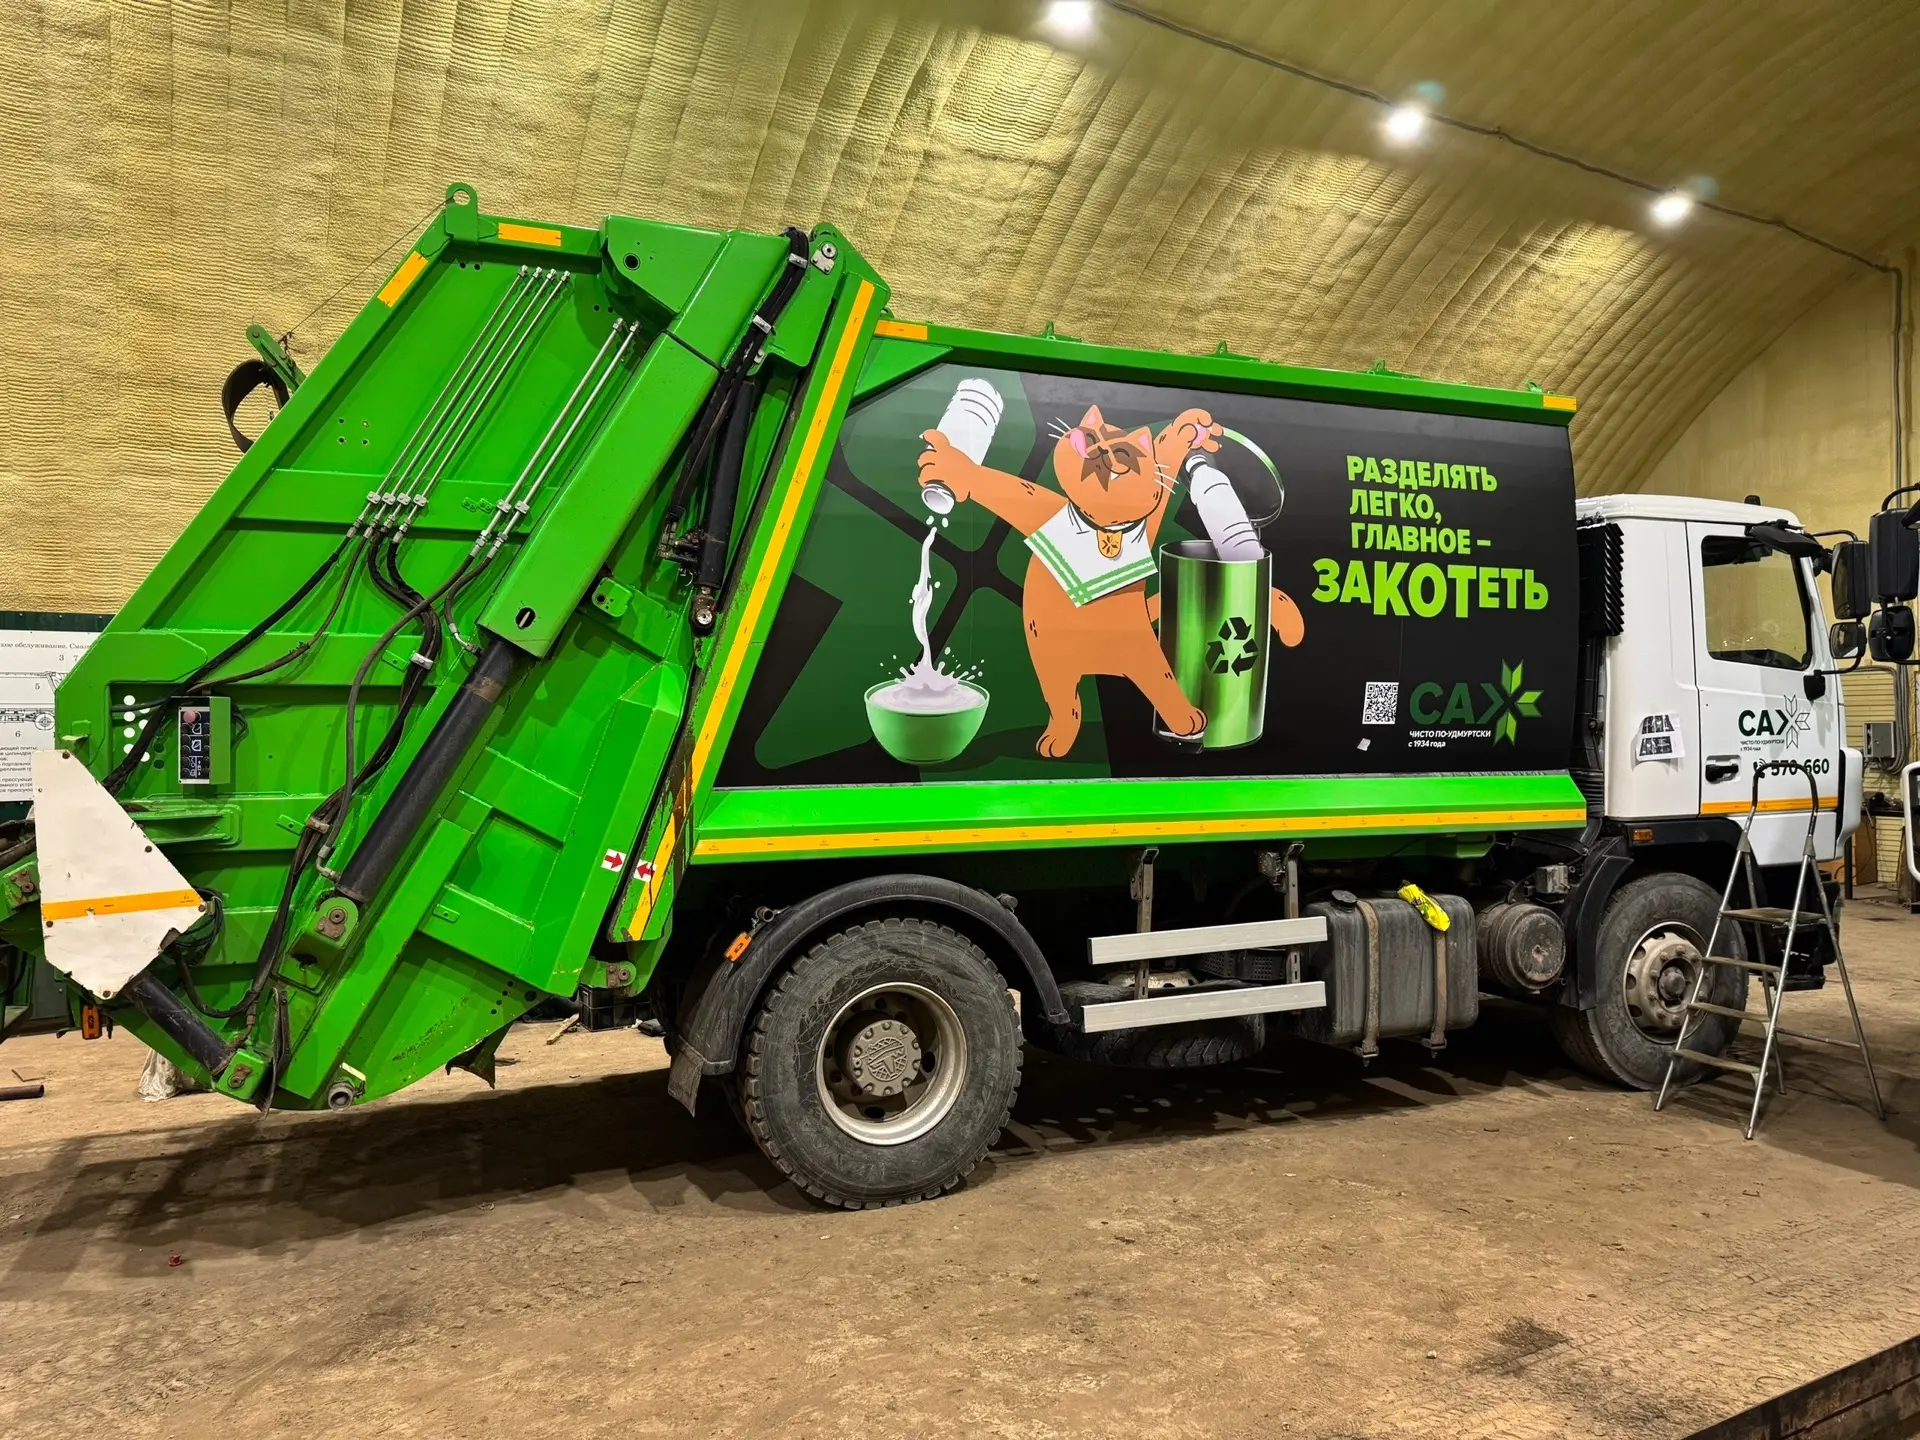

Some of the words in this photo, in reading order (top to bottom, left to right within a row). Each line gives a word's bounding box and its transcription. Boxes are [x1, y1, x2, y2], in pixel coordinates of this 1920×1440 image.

[1346, 455, 1498, 492] РАЗДЕЛЯТЬ
[1350, 488, 1442, 524] ЛЕГКО,
[1351, 522, 1471, 554] ГЛАВНОЕ
[1311, 557, 1549, 618] ЗАКОТЕТЬ
[59, 654, 65, 662] 3
[34, 682, 41, 690] 5
[15, 730, 21, 738] 6
[1409, 730, 1435, 738] ЧИСТО
[1435, 729, 1492, 739] ПО-УДМУРТСКИ
[1413, 740, 1430, 748] 1934
[1430, 741, 1447, 749] года
